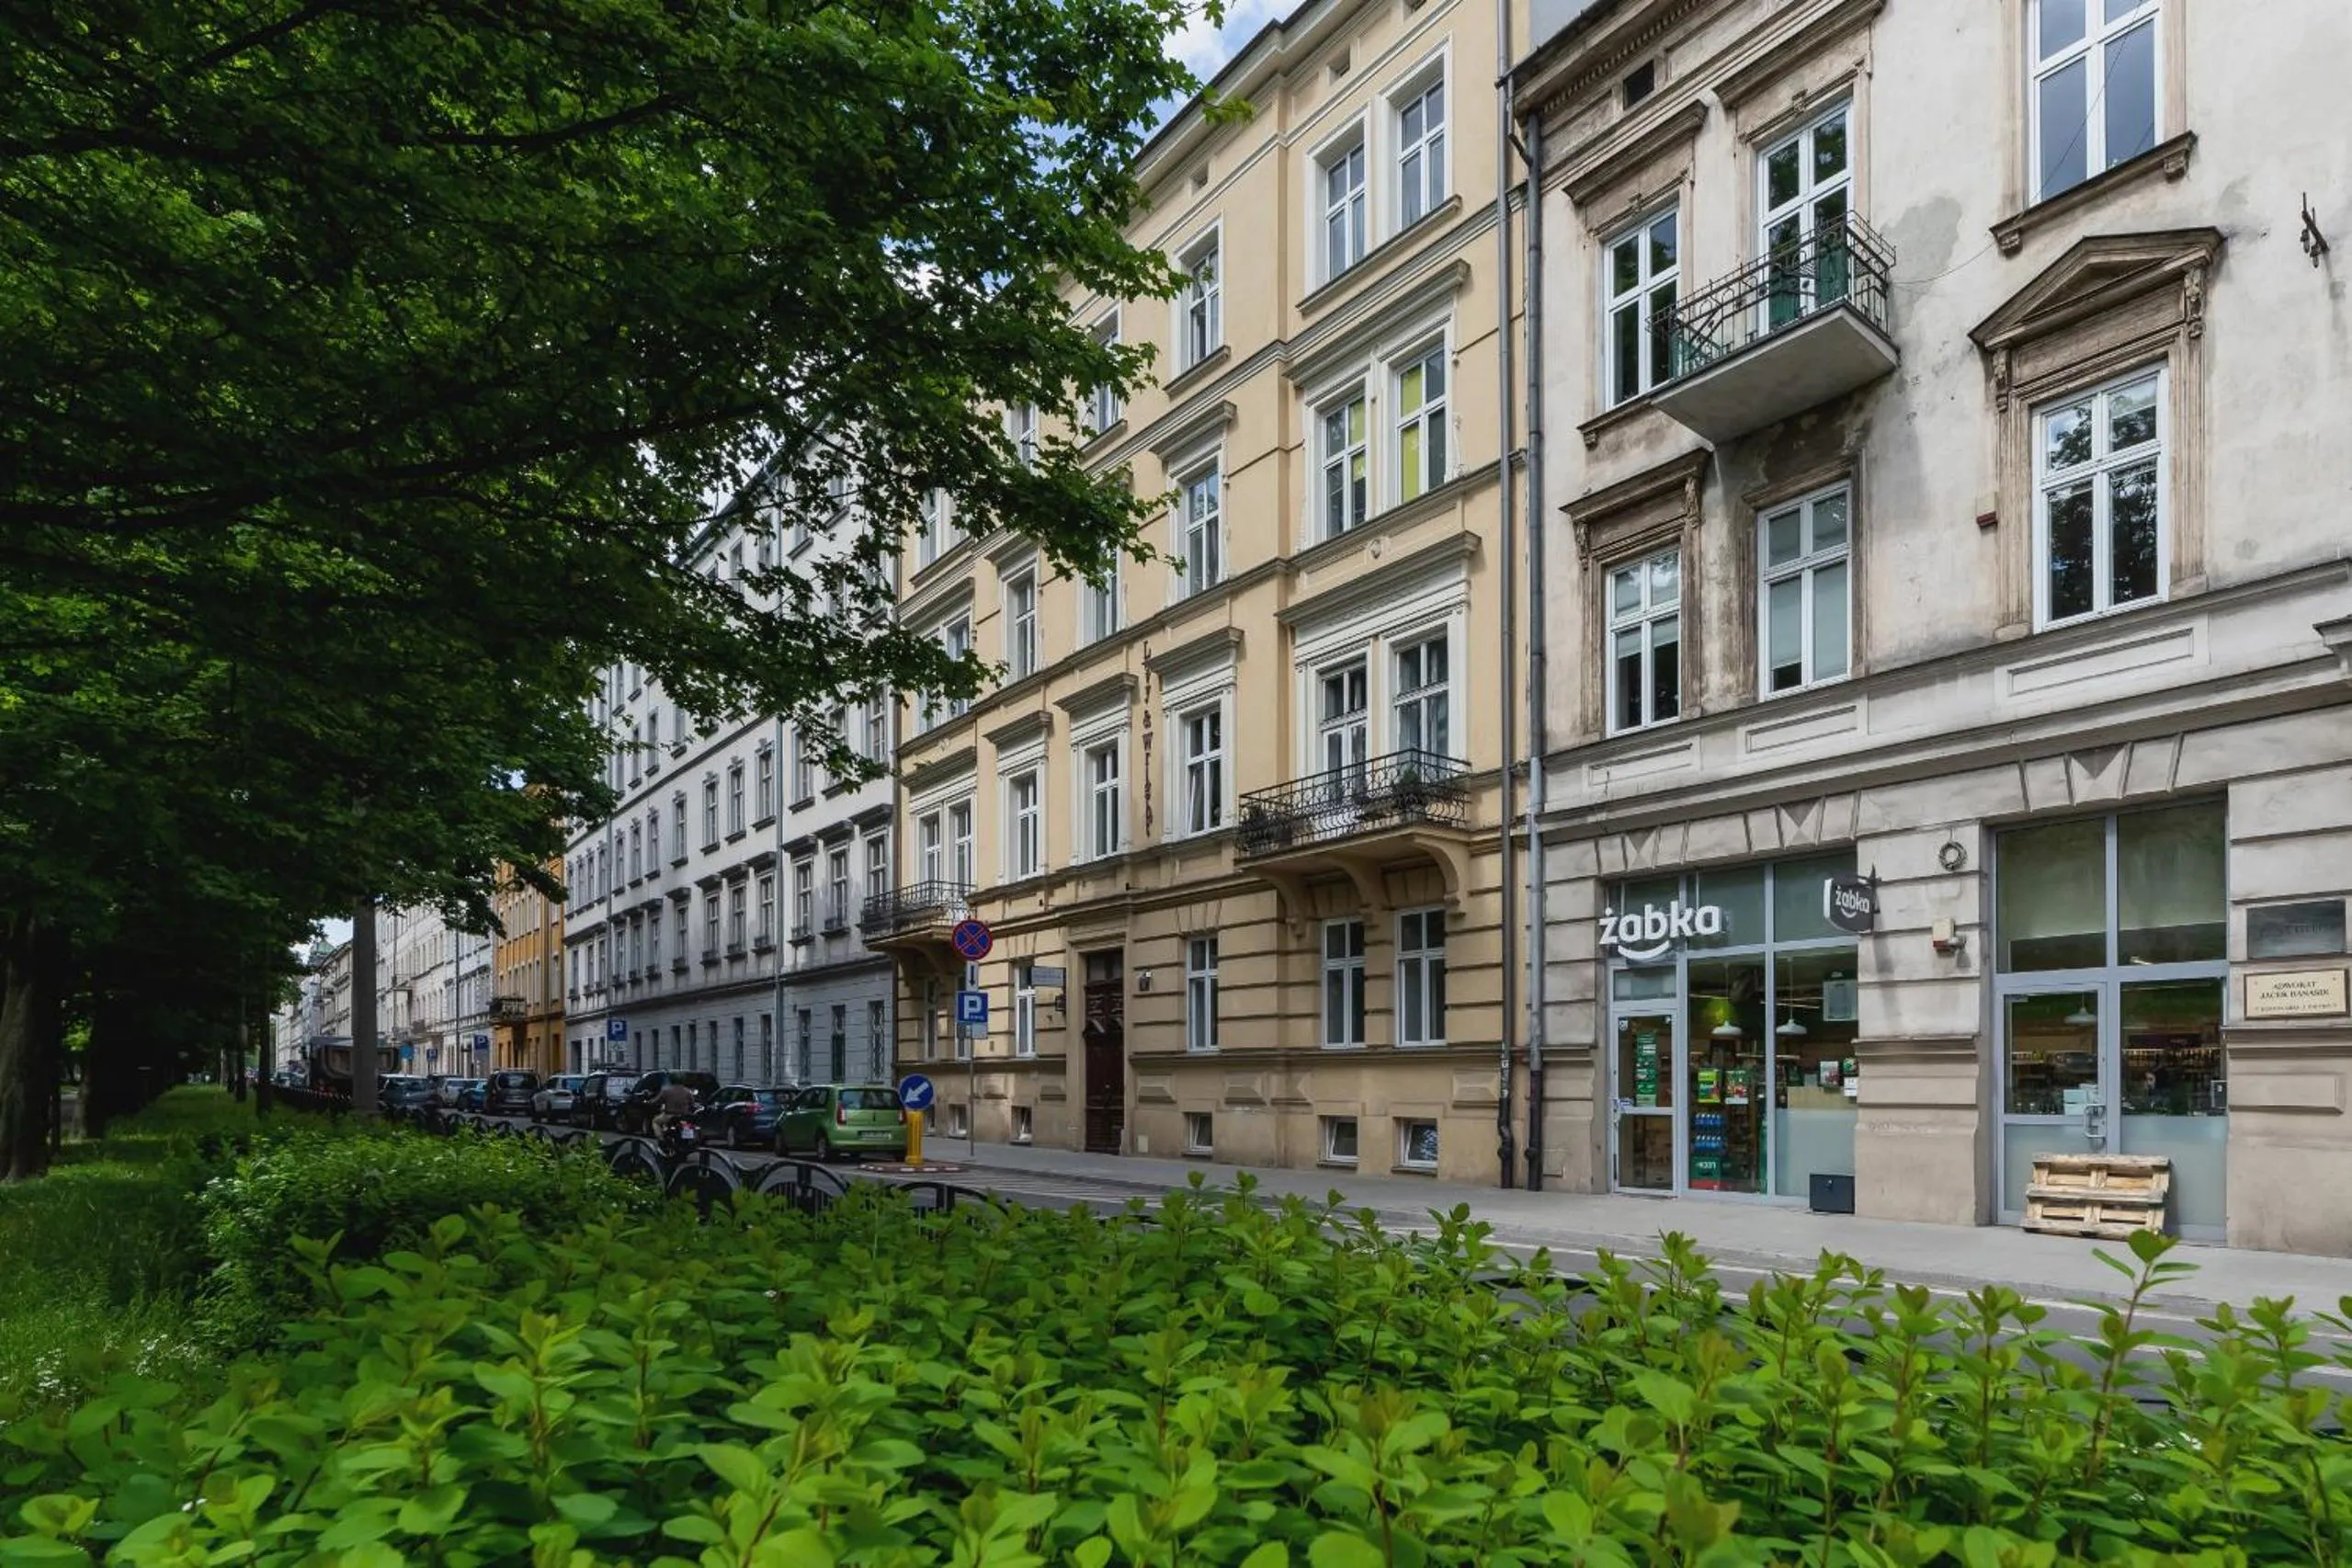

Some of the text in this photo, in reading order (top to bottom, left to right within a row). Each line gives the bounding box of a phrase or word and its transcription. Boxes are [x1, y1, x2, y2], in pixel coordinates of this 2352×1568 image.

[1835, 885, 1870, 914] żabka
[1598, 901, 1722, 945] żabka
[963, 995, 983, 1019] P
[611, 1021, 623, 1035] P
